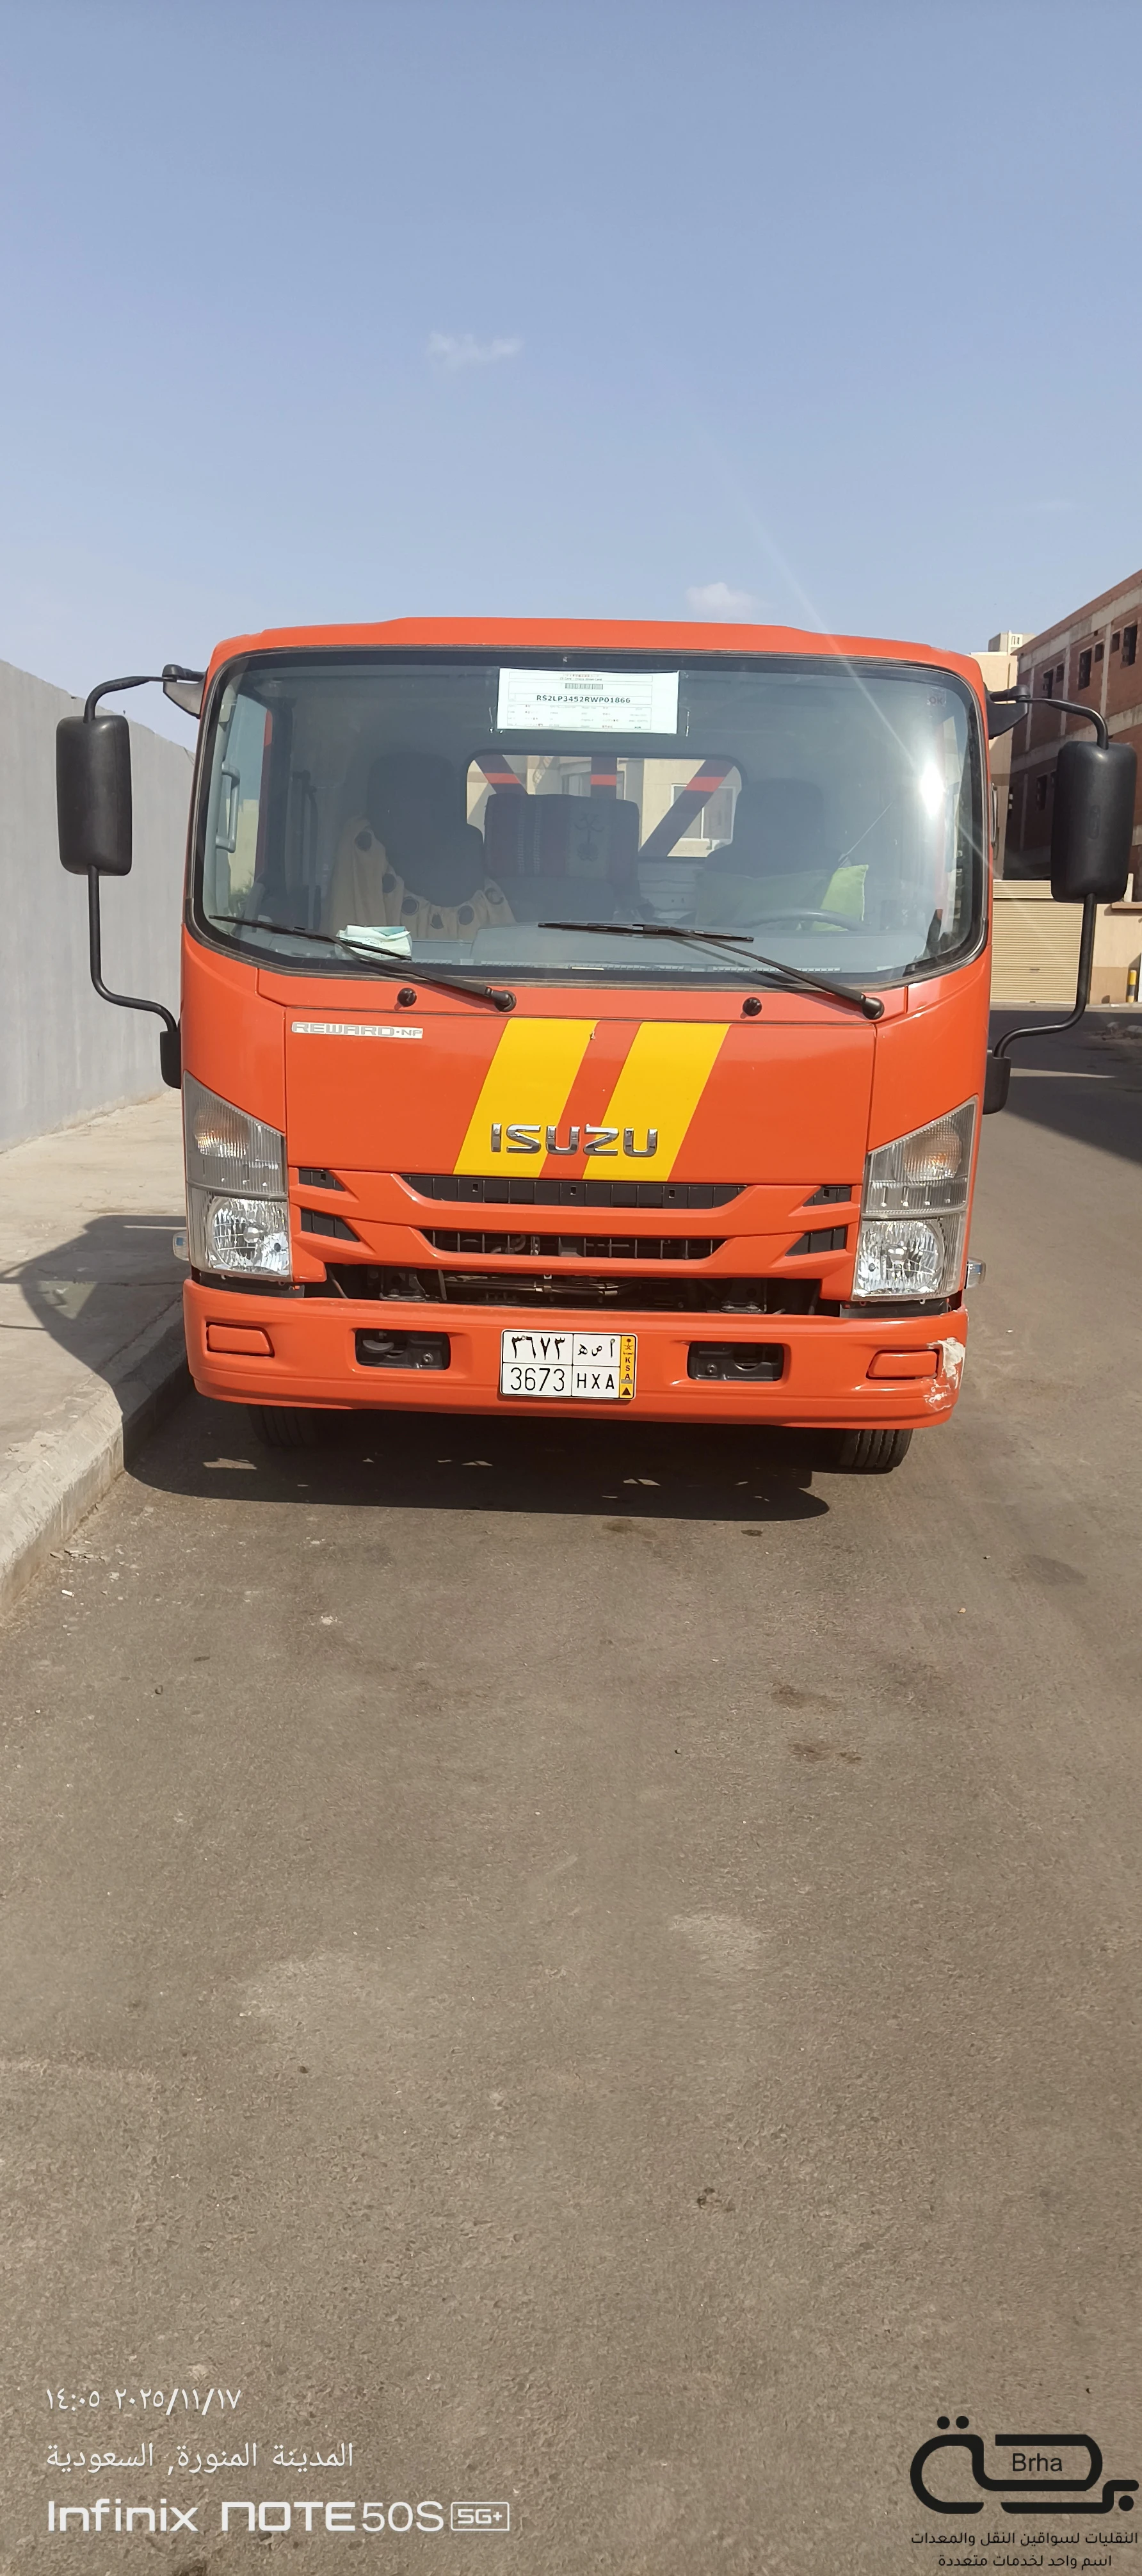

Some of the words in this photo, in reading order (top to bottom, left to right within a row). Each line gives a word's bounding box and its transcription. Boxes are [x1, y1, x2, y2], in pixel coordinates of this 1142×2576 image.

[536, 695, 631, 704] RS2LP3452RWP01866
[491, 1122, 657, 1157] ISUZU
[510, 1367, 565, 1392] 3673
